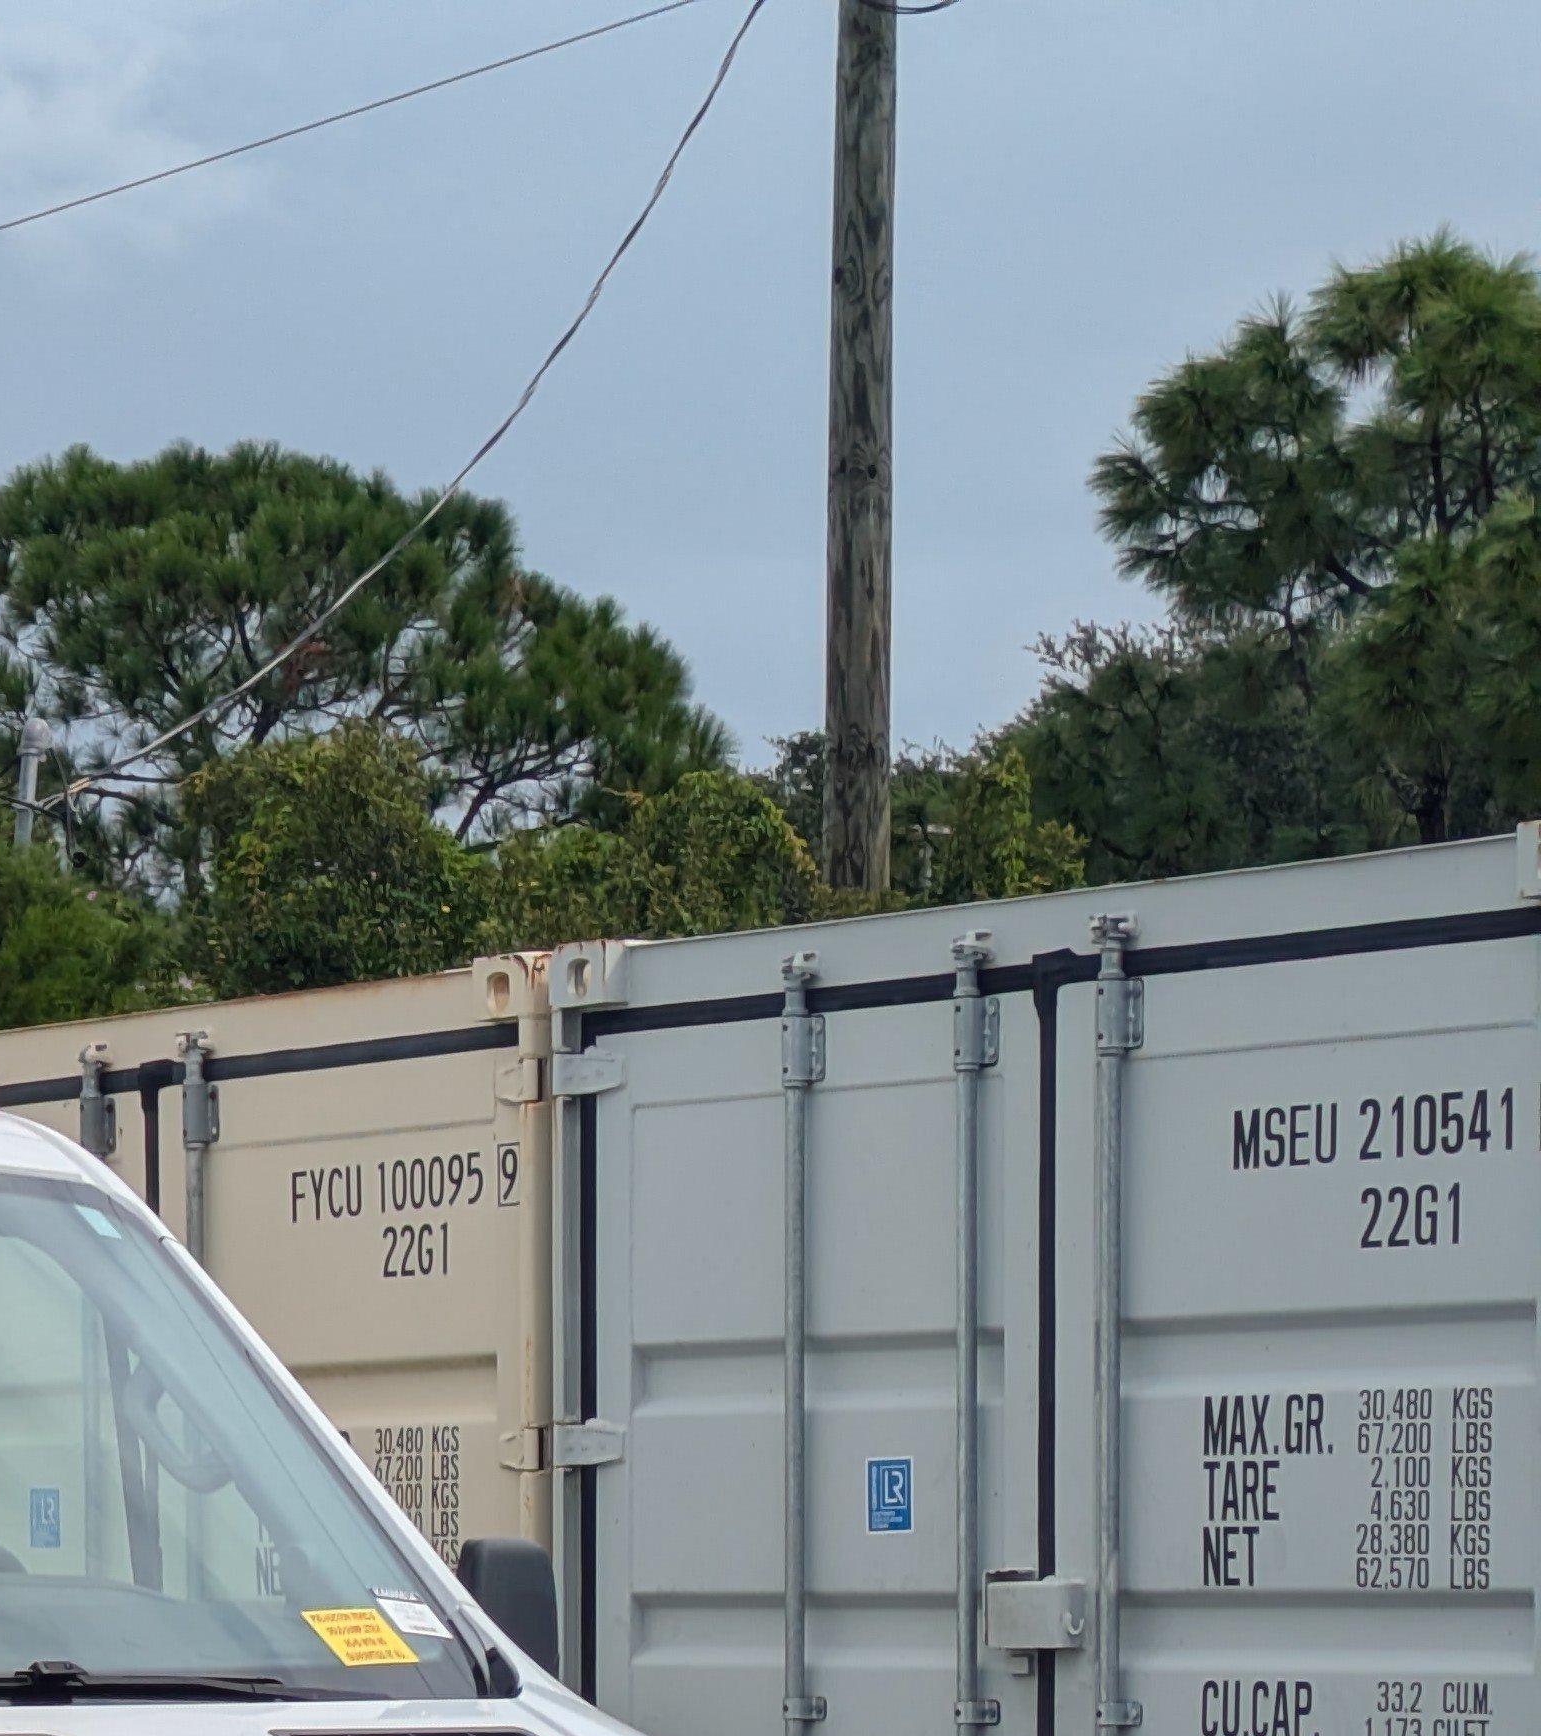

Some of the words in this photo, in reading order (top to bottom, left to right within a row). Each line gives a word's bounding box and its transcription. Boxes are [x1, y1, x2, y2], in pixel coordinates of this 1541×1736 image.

[1233, 1102, 1337, 1170] MSEU
[1359, 1087, 1513, 1160] 210541
[292, 1164, 362, 1223] FYCU
[378, 1152, 483, 1213] 100095
[501, 1148, 518, 1201] 9
[1360, 1182, 1460, 1248] 22G1
[383, 1222, 448, 1277] 22G1
[1358, 1388, 1432, 1421] 30,480
[1453, 1387, 1493, 1420] KGS
[375, 1427, 423, 1454] 30,480
[432, 1426, 460, 1452] KGS
[1203, 1393, 1333, 1456] MAX.GR.
[1357, 1422, 1431, 1455] 67,200
[1452, 1421, 1492, 1454] LBS
[375, 1455, 423, 1483] 67,200
[432, 1454, 459, 1481] LBS
[1370, 1456, 1430, 1489] 2,100
[1451, 1455, 1492, 1488] KGS
[432, 1483, 459, 1509] KGS
[884, 1469, 904, 1504] LR
[1203, 1461, 1280, 1522] TARE
[1370, 1490, 1430, 1523] 4,630
[1451, 1490, 1491, 1522] LBS
[431, 1511, 459, 1537] LBS
[1356, 1524, 1429, 1556] 28,380
[1450, 1523, 1491, 1556] KGS
[1203, 1526, 1259, 1586] NET
[1356, 1557, 1429, 1590] 62,570
[1450, 1557, 1490, 1590] LBS
[1377, 1682, 1422, 1713] 33.2
[1443, 1682, 1493, 1715] CU.M.
